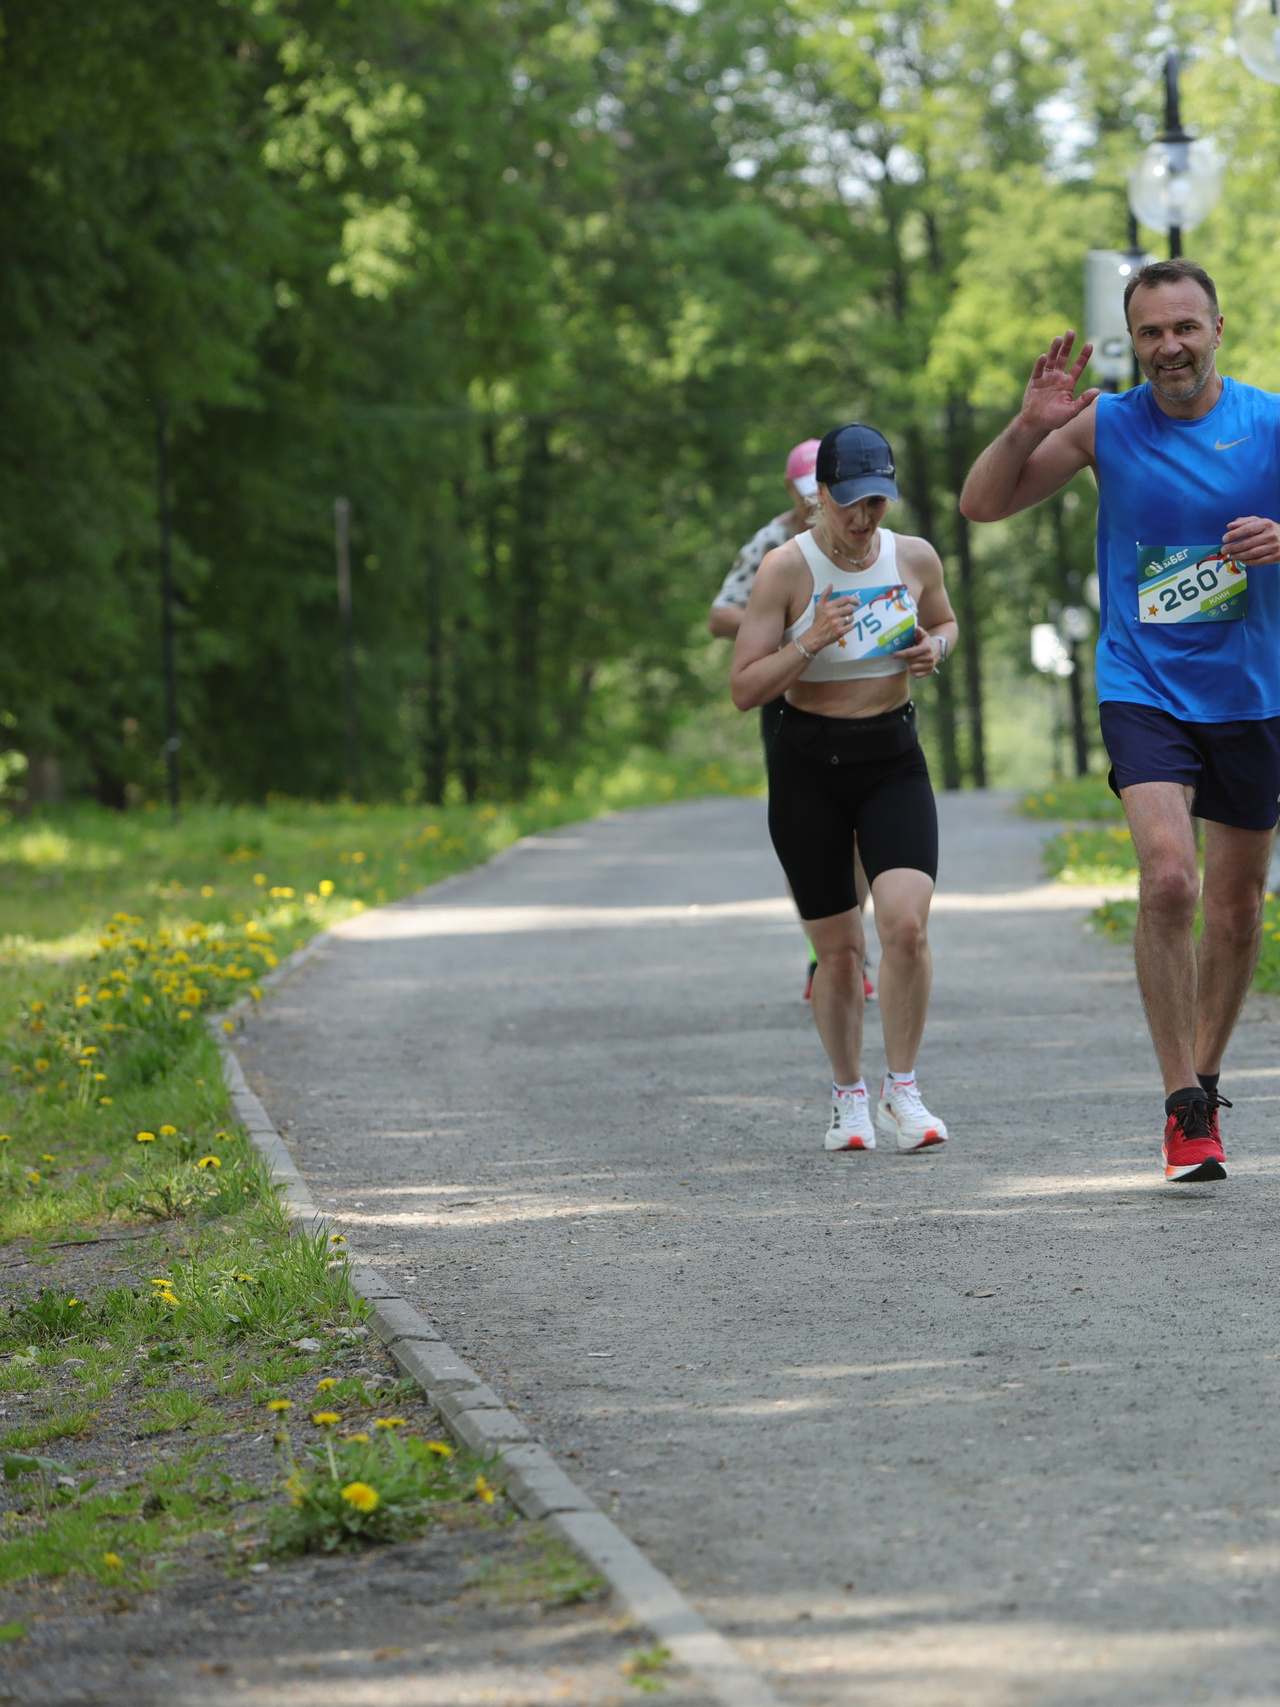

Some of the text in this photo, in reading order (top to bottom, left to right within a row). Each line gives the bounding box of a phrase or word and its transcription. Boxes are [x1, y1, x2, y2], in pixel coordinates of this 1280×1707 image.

[1159, 569, 1218, 612] 260
[1208, 589, 1231, 605] КЛИН
[853, 611, 882, 642] 75
